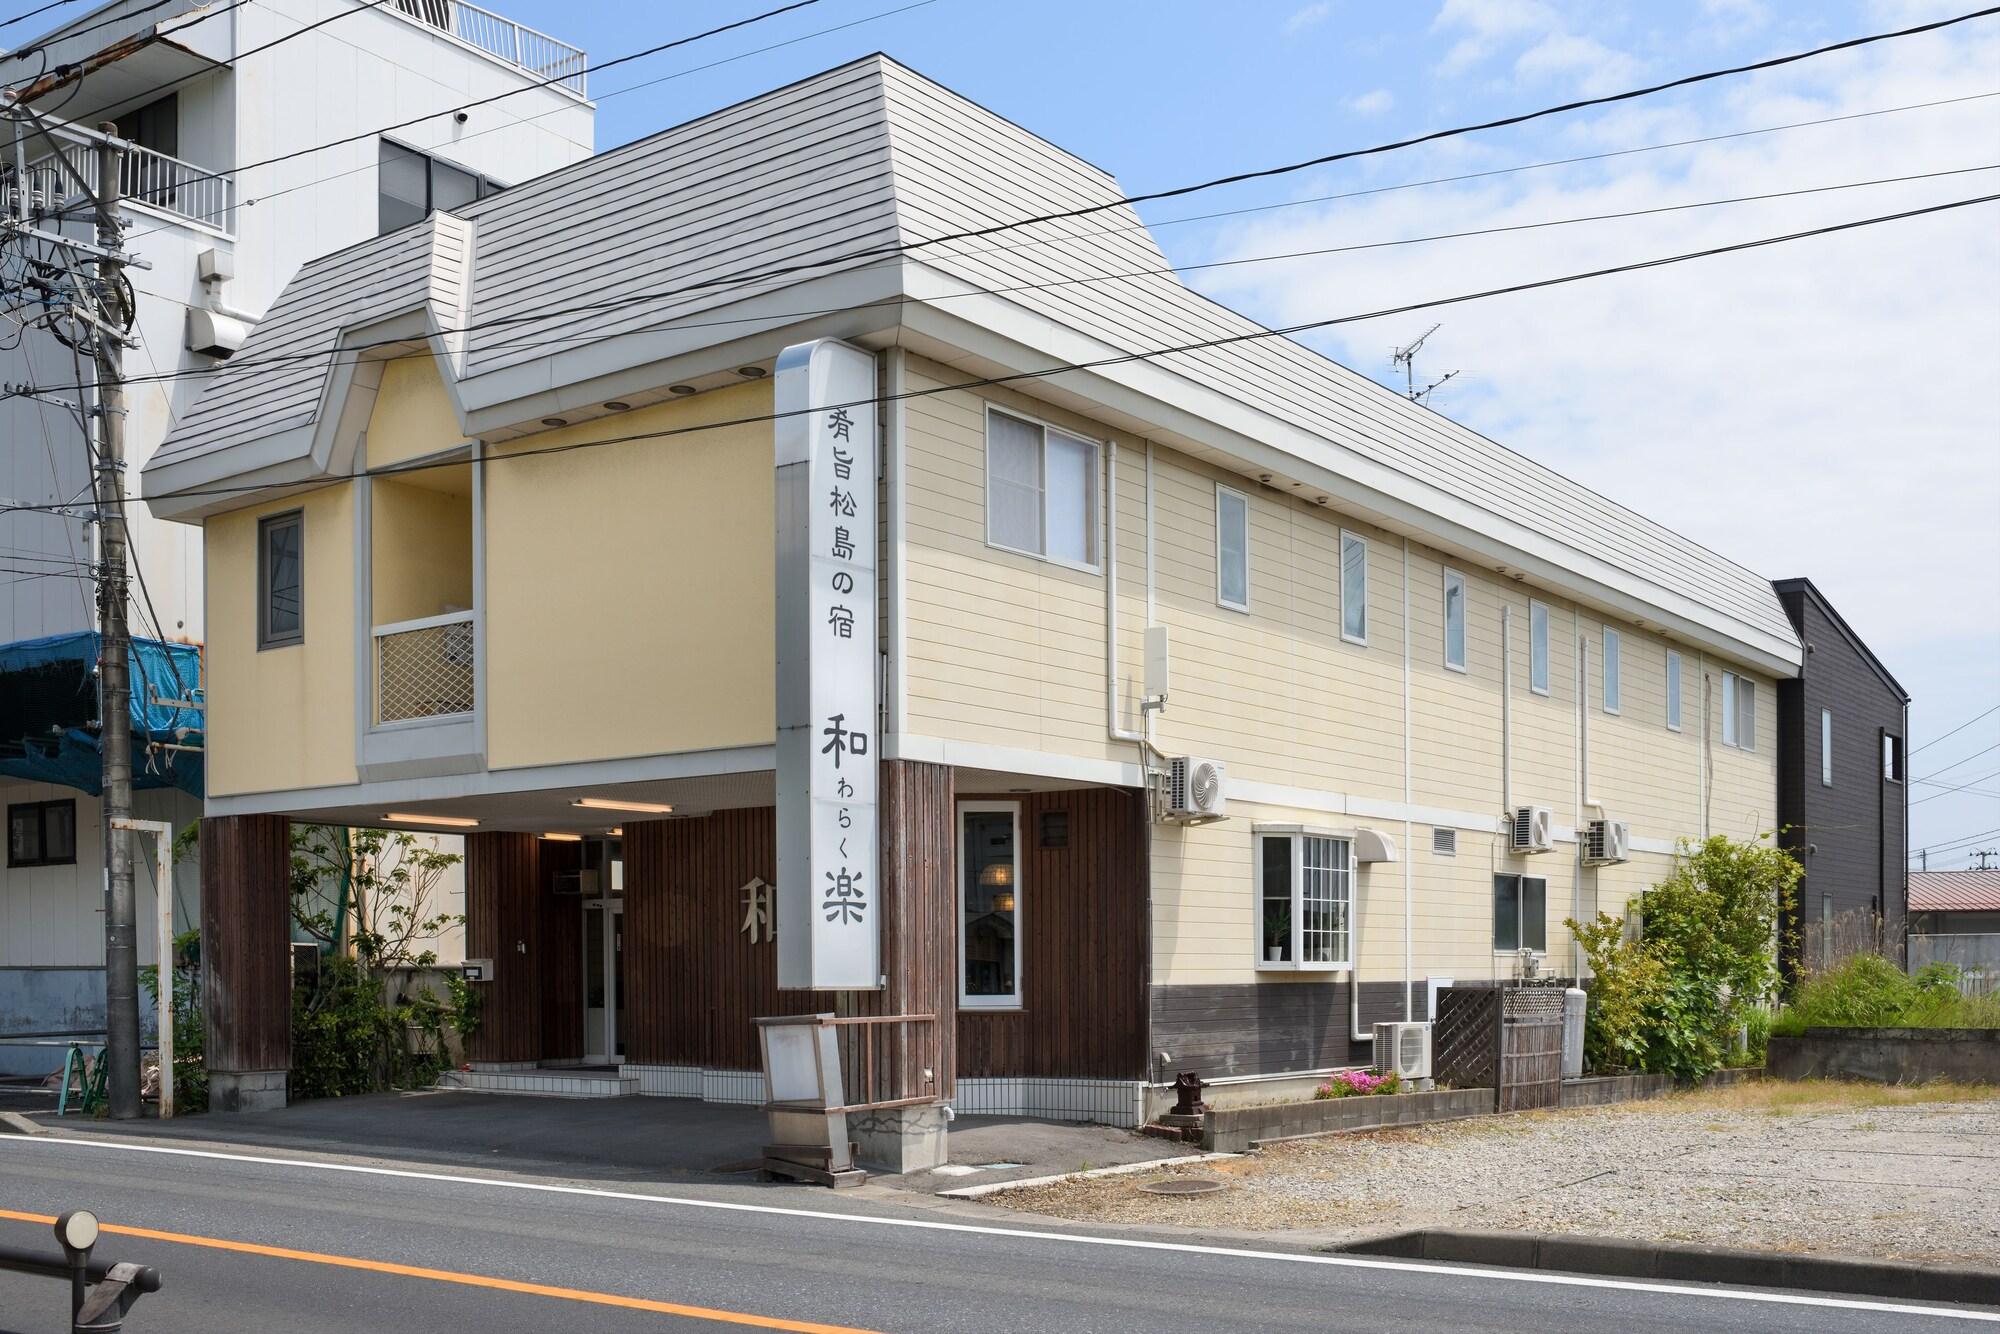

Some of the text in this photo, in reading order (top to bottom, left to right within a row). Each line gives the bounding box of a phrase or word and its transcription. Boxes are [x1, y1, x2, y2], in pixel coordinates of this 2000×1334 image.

[828, 407, 858, 639] 肴旨松島の宿
